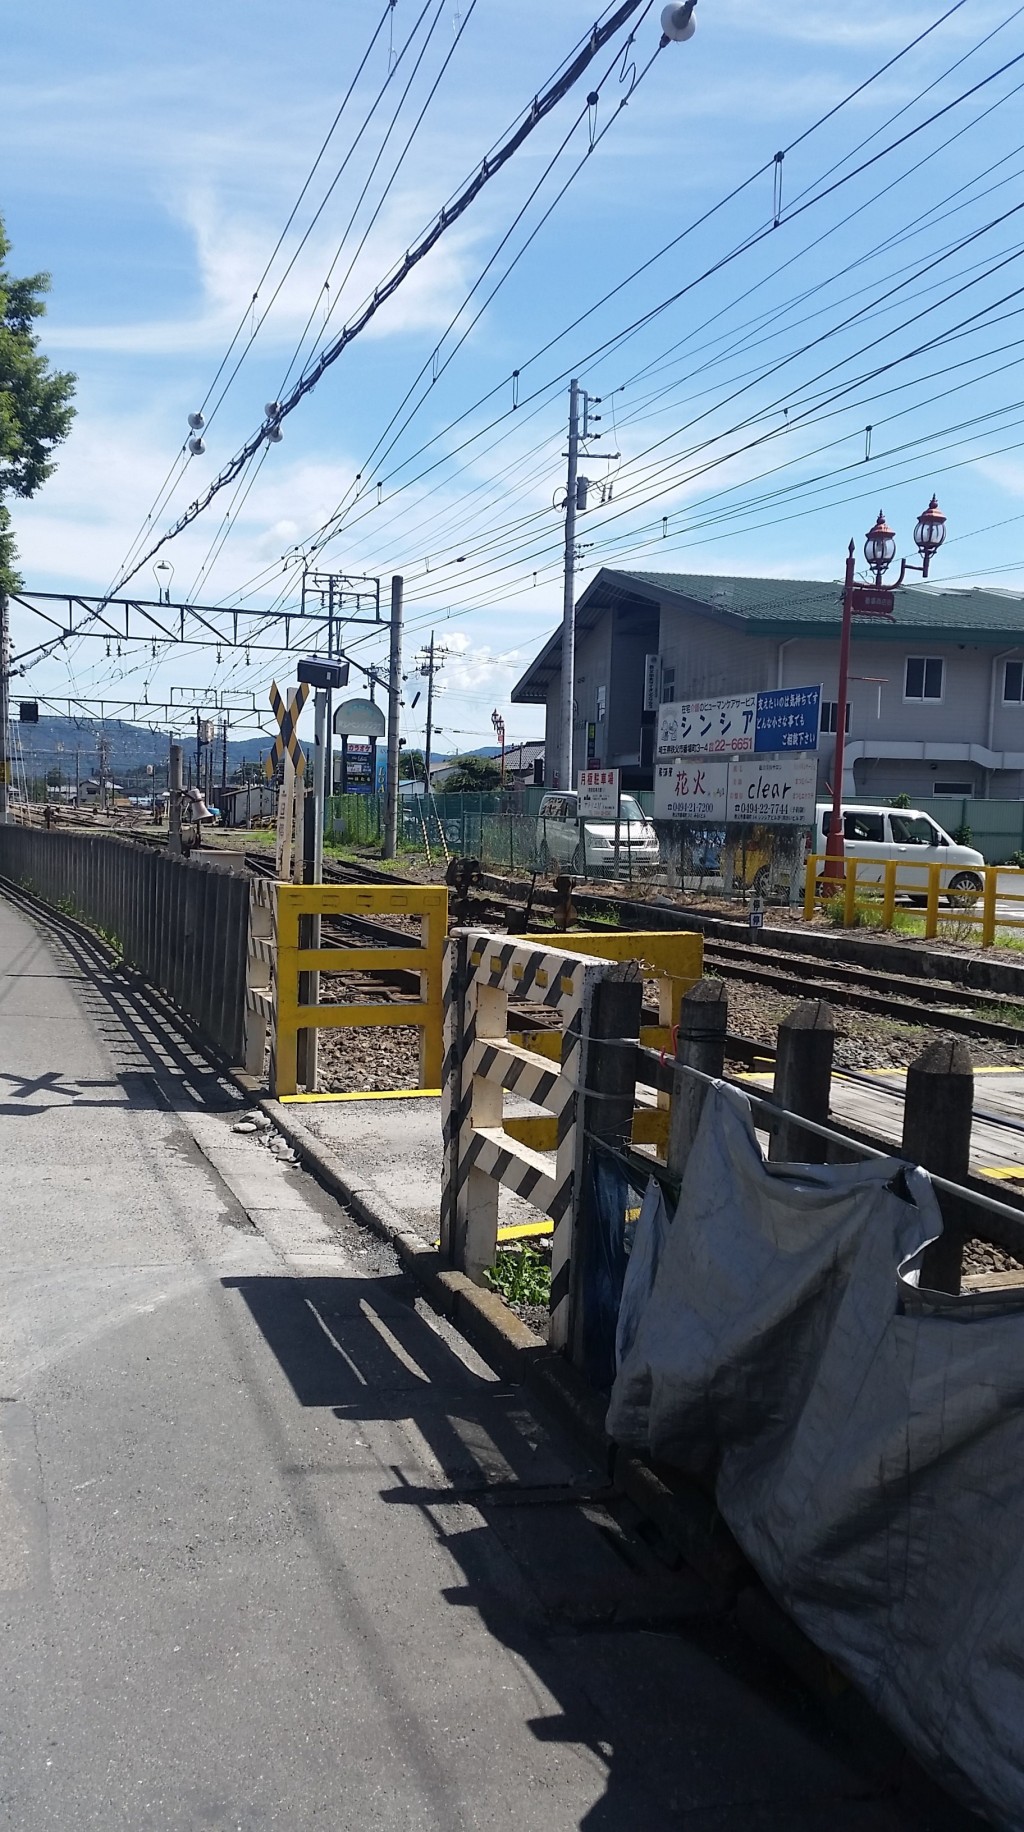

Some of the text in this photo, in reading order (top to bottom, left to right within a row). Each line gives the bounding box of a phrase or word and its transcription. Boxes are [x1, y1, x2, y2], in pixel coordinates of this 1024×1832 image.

[757, 691, 819, 711] 支えたいのは気持ちです
[680, 710, 754, 738] シンシア
[756, 713, 805, 729] どんな小さな事でも
[714, 737, 753, 752] 22-6651
[580, 771, 614, 786] 月極駐車場
[674, 769, 706, 797] 花火
[747, 775, 792, 800] clear
[740, 802, 789, 815] 0494-22-7744
